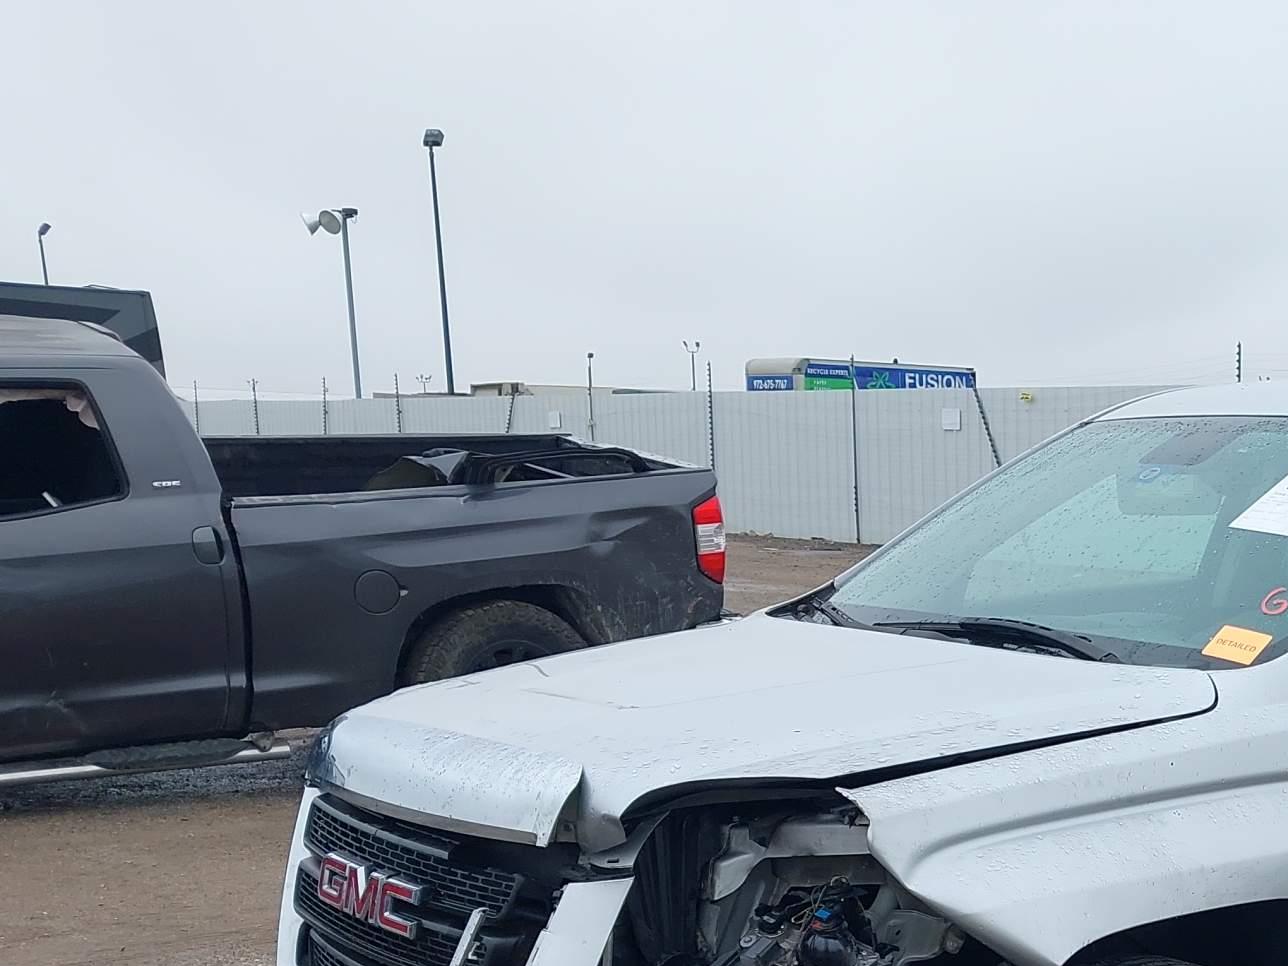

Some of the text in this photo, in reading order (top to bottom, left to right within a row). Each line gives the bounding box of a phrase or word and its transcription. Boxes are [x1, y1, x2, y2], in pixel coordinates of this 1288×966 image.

[904, 372, 967, 389] FUSION
[1216, 638, 1258, 653] DETAILED
[318, 852, 422, 940] GMC
